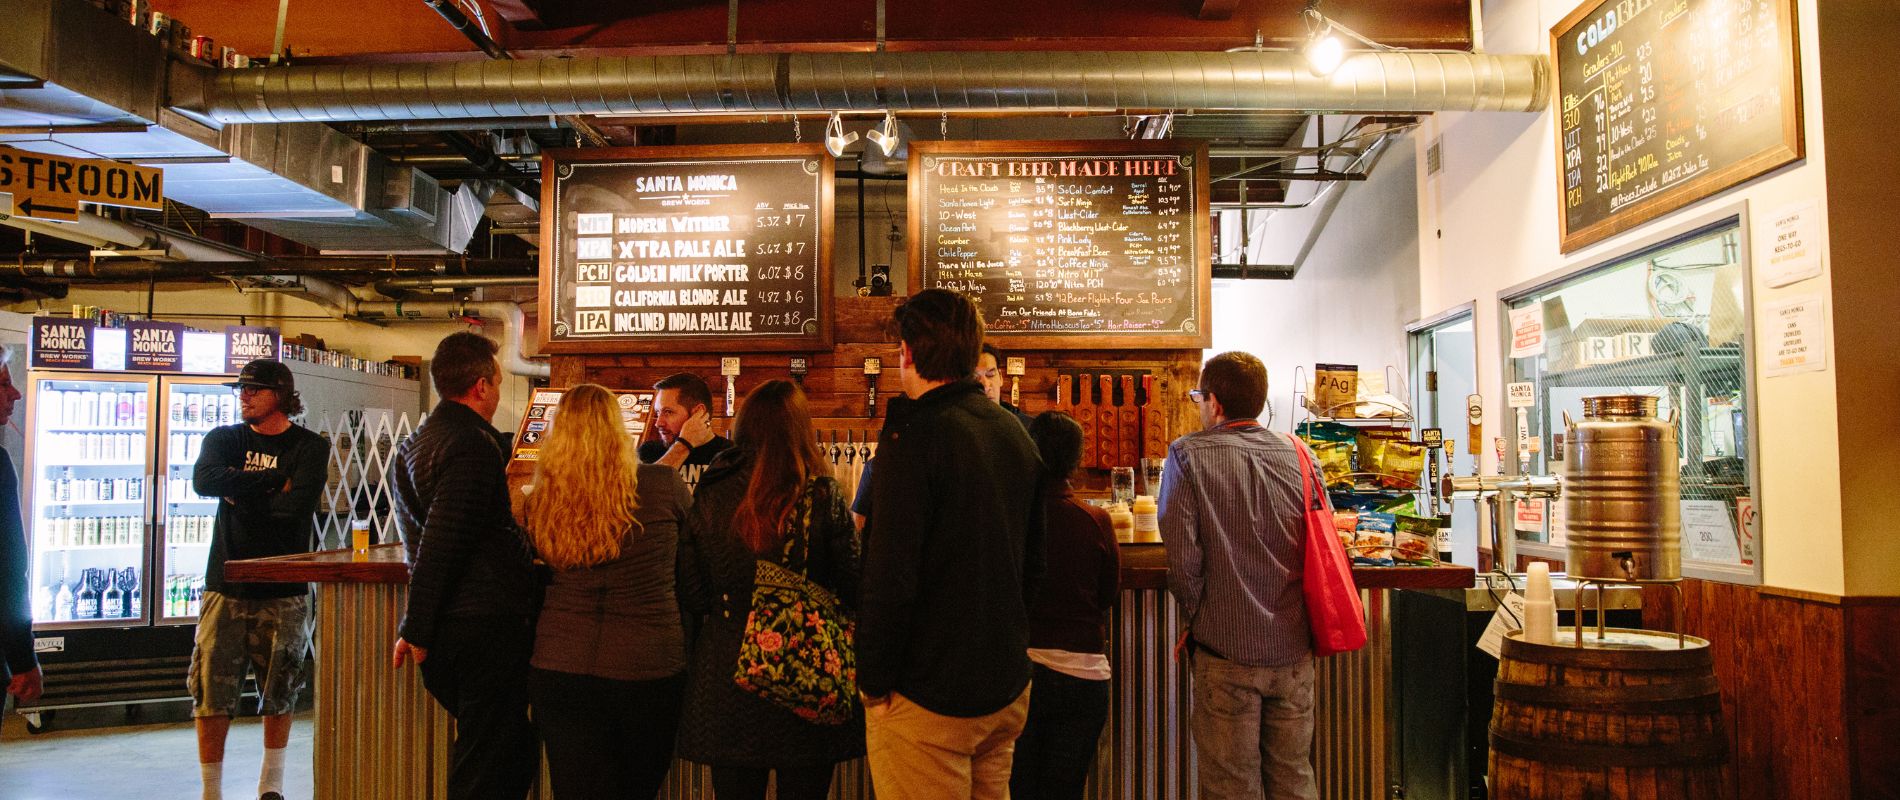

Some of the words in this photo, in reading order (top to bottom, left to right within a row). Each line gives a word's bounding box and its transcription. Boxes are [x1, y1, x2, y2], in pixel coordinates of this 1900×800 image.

[1577, 9, 1617, 56] COLD
[1564, 108, 1581, 132] 310
[1566, 147, 1582, 170] XPA
[938, 162, 1001, 177] CRAFT
[1060, 161, 1120, 176] MADE
[1124, 160, 1178, 176] HERE
[636, 176, 683, 192] SANTA
[688, 175, 738, 191] MONICA
[1567, 165, 1582, 190] IPA
[1634, 177, 1658, 198] Include
[1057, 197, 1074, 207] Surf
[1568, 186, 1582, 209] PCH
[619, 218, 667, 233] MODERN
[940, 222, 960, 232] Ocean
[962, 221, 976, 232] Park
[1058, 222, 1094, 234] Blackberry
[939, 235, 970, 245] Cucumber
[674, 240, 711, 257] PALE
[713, 240, 746, 257] ALE
[957, 247, 978, 259] Pepper
[1058, 246, 1092, 257] Breakfast
[1093, 245, 1110, 256] Beer
[961, 261, 974, 269] Will
[1059, 258, 1087, 268] Coffee
[1089, 259, 1109, 271] Ninja
[579, 264, 608, 280] PCH
[615, 264, 667, 282] GOLDEN
[670, 264, 702, 282] MILK
[705, 264, 749, 282] PORTER
[1058, 269, 1079, 278] Nitro
[1082, 269, 1100, 278] WIT
[968, 280, 987, 292] Ninja
[1064, 280, 1085, 289] Nitro
[1087, 279, 1104, 288] PCH
[614, 290, 677, 306] CALIFORNIA
[680, 289, 719, 306] BLONDE
[722, 289, 747, 306] ALE
[1067, 292, 1087, 303] Beer
[1115, 292, 1133, 304] Four
[1151, 292, 1173, 304] Pours
[1001, 307, 1017, 316] From
[1019, 307, 1032, 316] Our
[1032, 307, 1057, 316] Friends
[1058, 309, 1067, 317] At
[579, 312, 607, 330] IPA
[614, 313, 665, 332] INCLINED
[668, 312, 700, 332] INDIA
[701, 312, 728, 331] PALE
[730, 312, 752, 331] ALE
[1030, 320, 1050, 330] Nitro
[41, 325, 86, 339] SANTA
[133, 329, 176, 342] SANTA
[41, 338, 86, 350] MONICA
[232, 333, 272, 346] SANTA
[133, 341, 175, 353] MONICA
[231, 344, 272, 356] MONICA
[1330, 377, 1349, 393] Ag
[245, 450, 278, 470] SANTA
